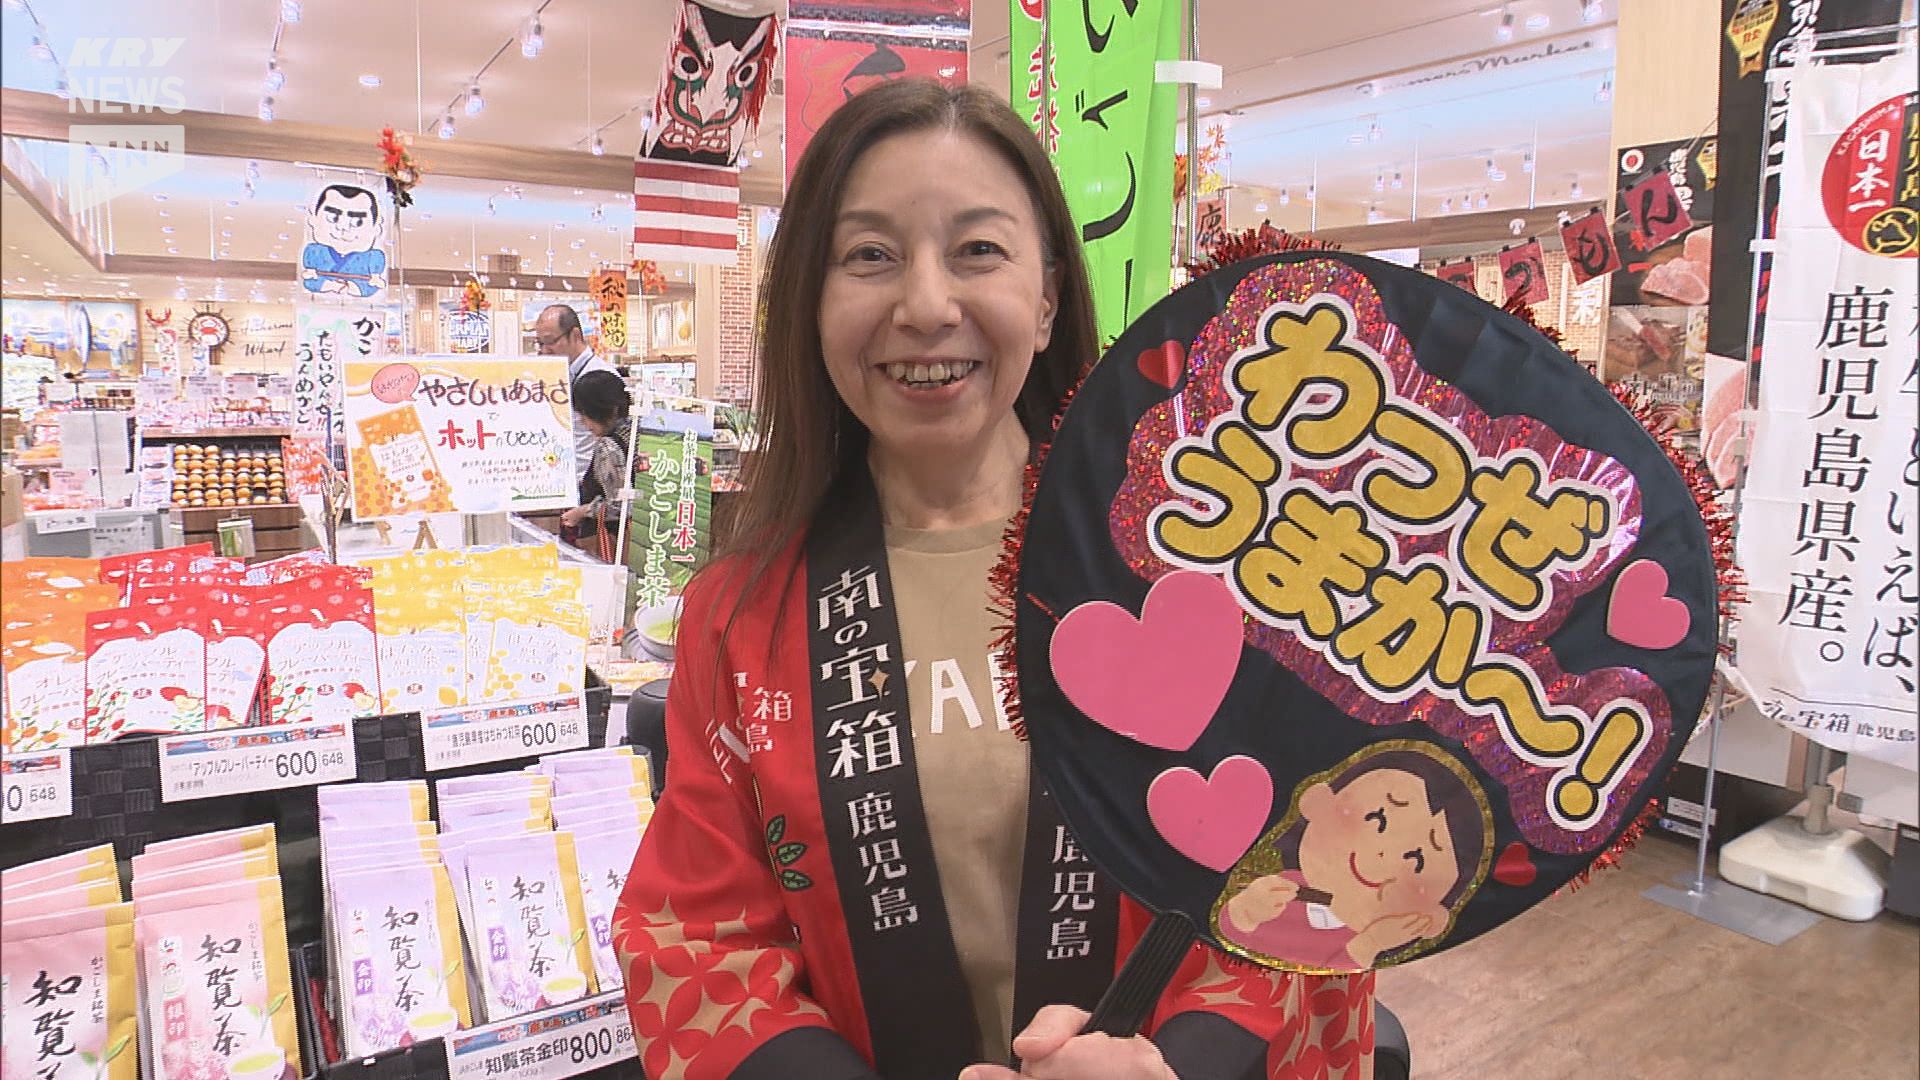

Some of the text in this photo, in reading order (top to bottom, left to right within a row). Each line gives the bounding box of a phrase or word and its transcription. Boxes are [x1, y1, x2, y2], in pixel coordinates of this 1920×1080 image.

[1848, 128, 1890, 213] 日本一
[418, 378, 569, 406] やさしいあまさ
[1776, 284, 1893, 663] 鹿児島県産。
[636, 448, 681, 608] かごしま茶
[817, 564, 905, 779] 南の宝箱
[275, 750, 317, 778] 600
[321, 751, 344, 766] 648
[521, 722, 556, 748] 600
[559, 722, 579, 737] 648
[1, 785, 57, 812] 0 648
[846, 790, 919, 932] 鹿児島
[378, 905, 426, 1013] 知覧茶
[508, 875, 556, 979] 知覧茶
[22, 970, 84, 1080] 知覧
[193, 934, 248, 1057] 知覧茶
[485, 1036, 569, 1076] 知覧茶金印
[570, 1028, 613, 1063] 800
